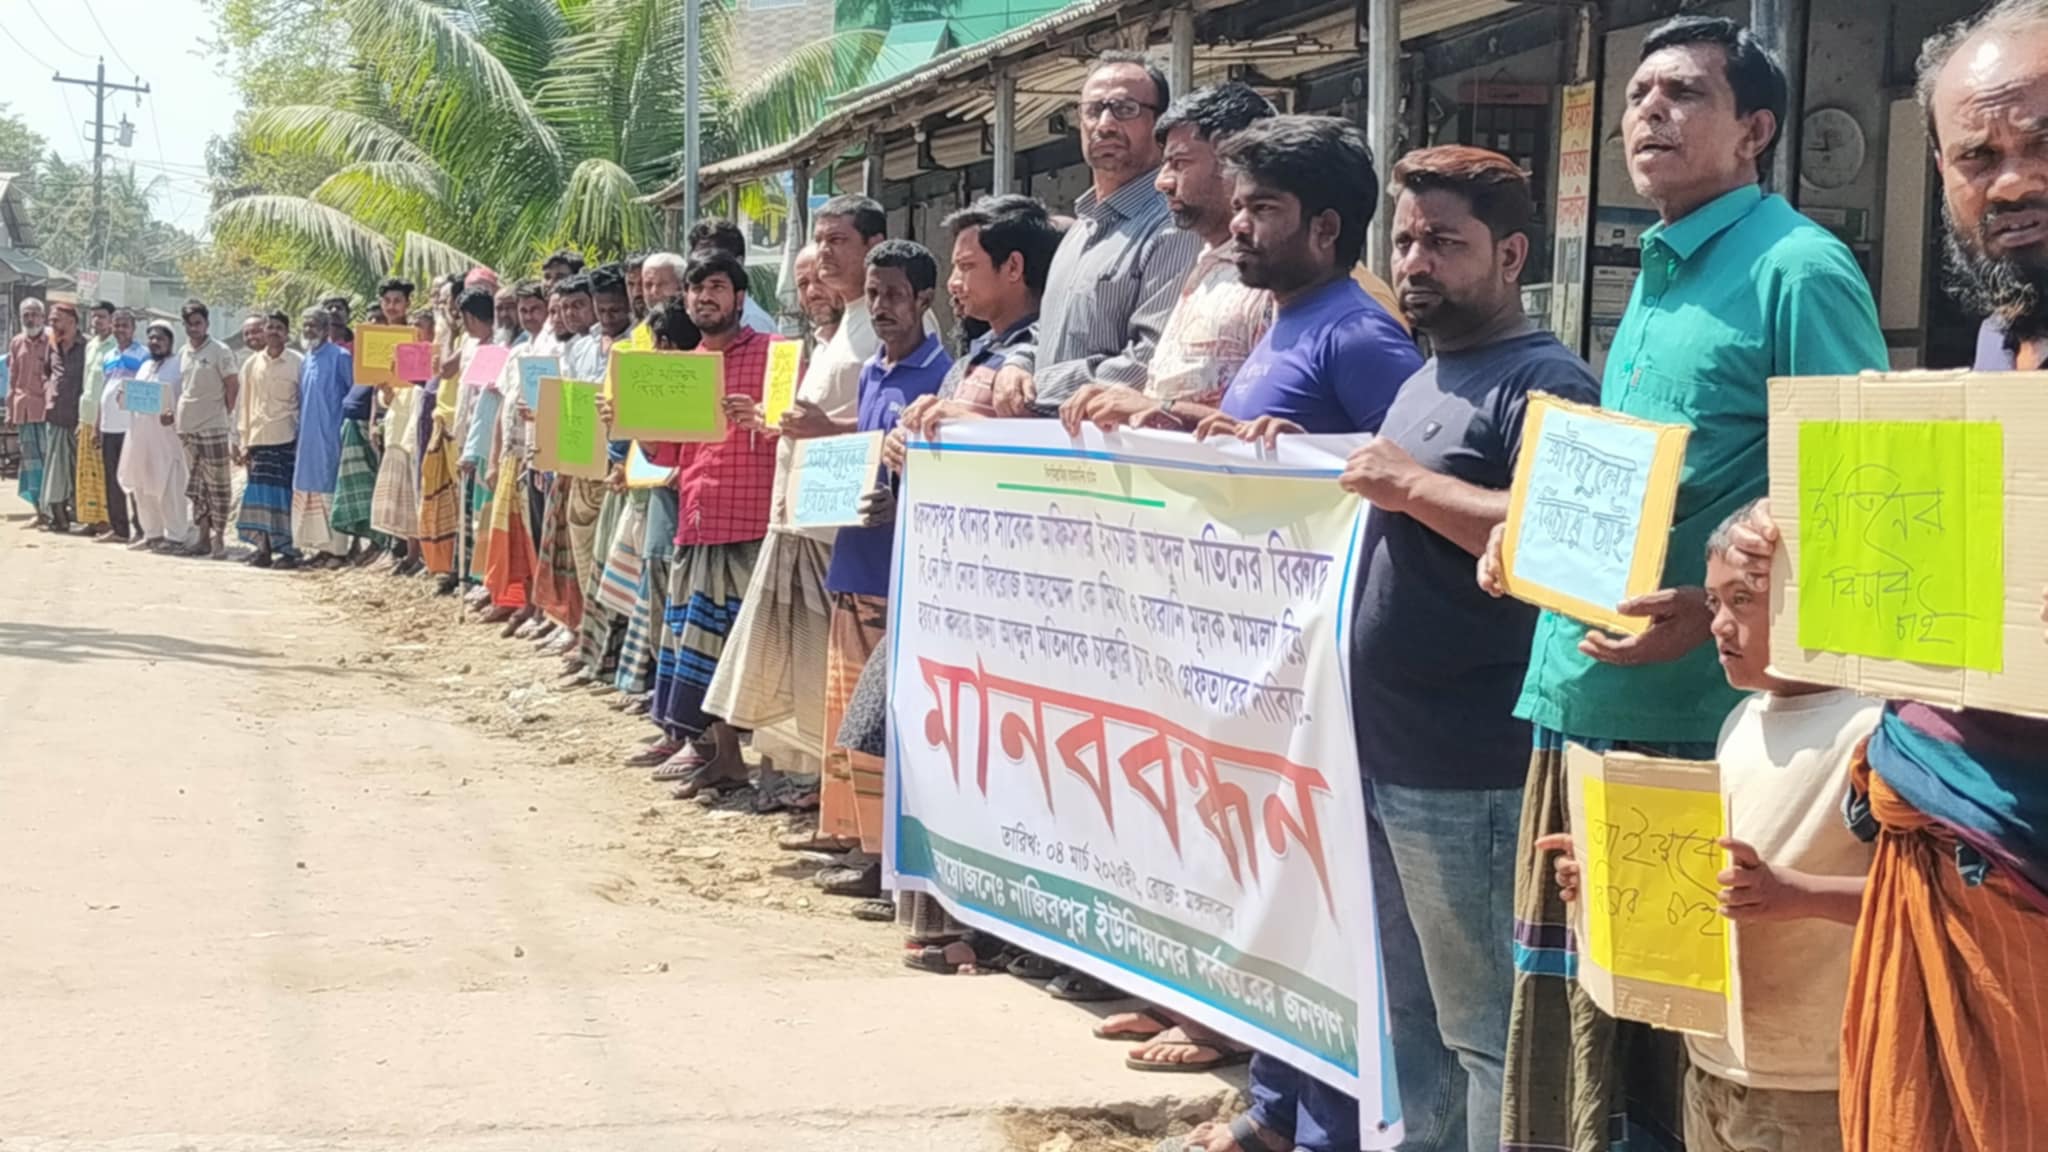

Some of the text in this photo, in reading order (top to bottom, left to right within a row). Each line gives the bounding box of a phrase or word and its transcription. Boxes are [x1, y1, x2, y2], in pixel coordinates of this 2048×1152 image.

[993, 510, 1034, 549] সাবেক
[1188, 523, 1263, 593] মতিনের
[1228, 611, 1278, 656] মামলা
[918, 654, 1334, 922] মানববন্ধন
[1047, 842, 1065, 865] ০৪
[1069, 842, 1090, 872] মার্চ
[1006, 874, 1090, 945] নাজিরপুর
[1093, 896, 1192, 980] ইউনিয়নের
[1279, 985, 1347, 1053] জনগণ
